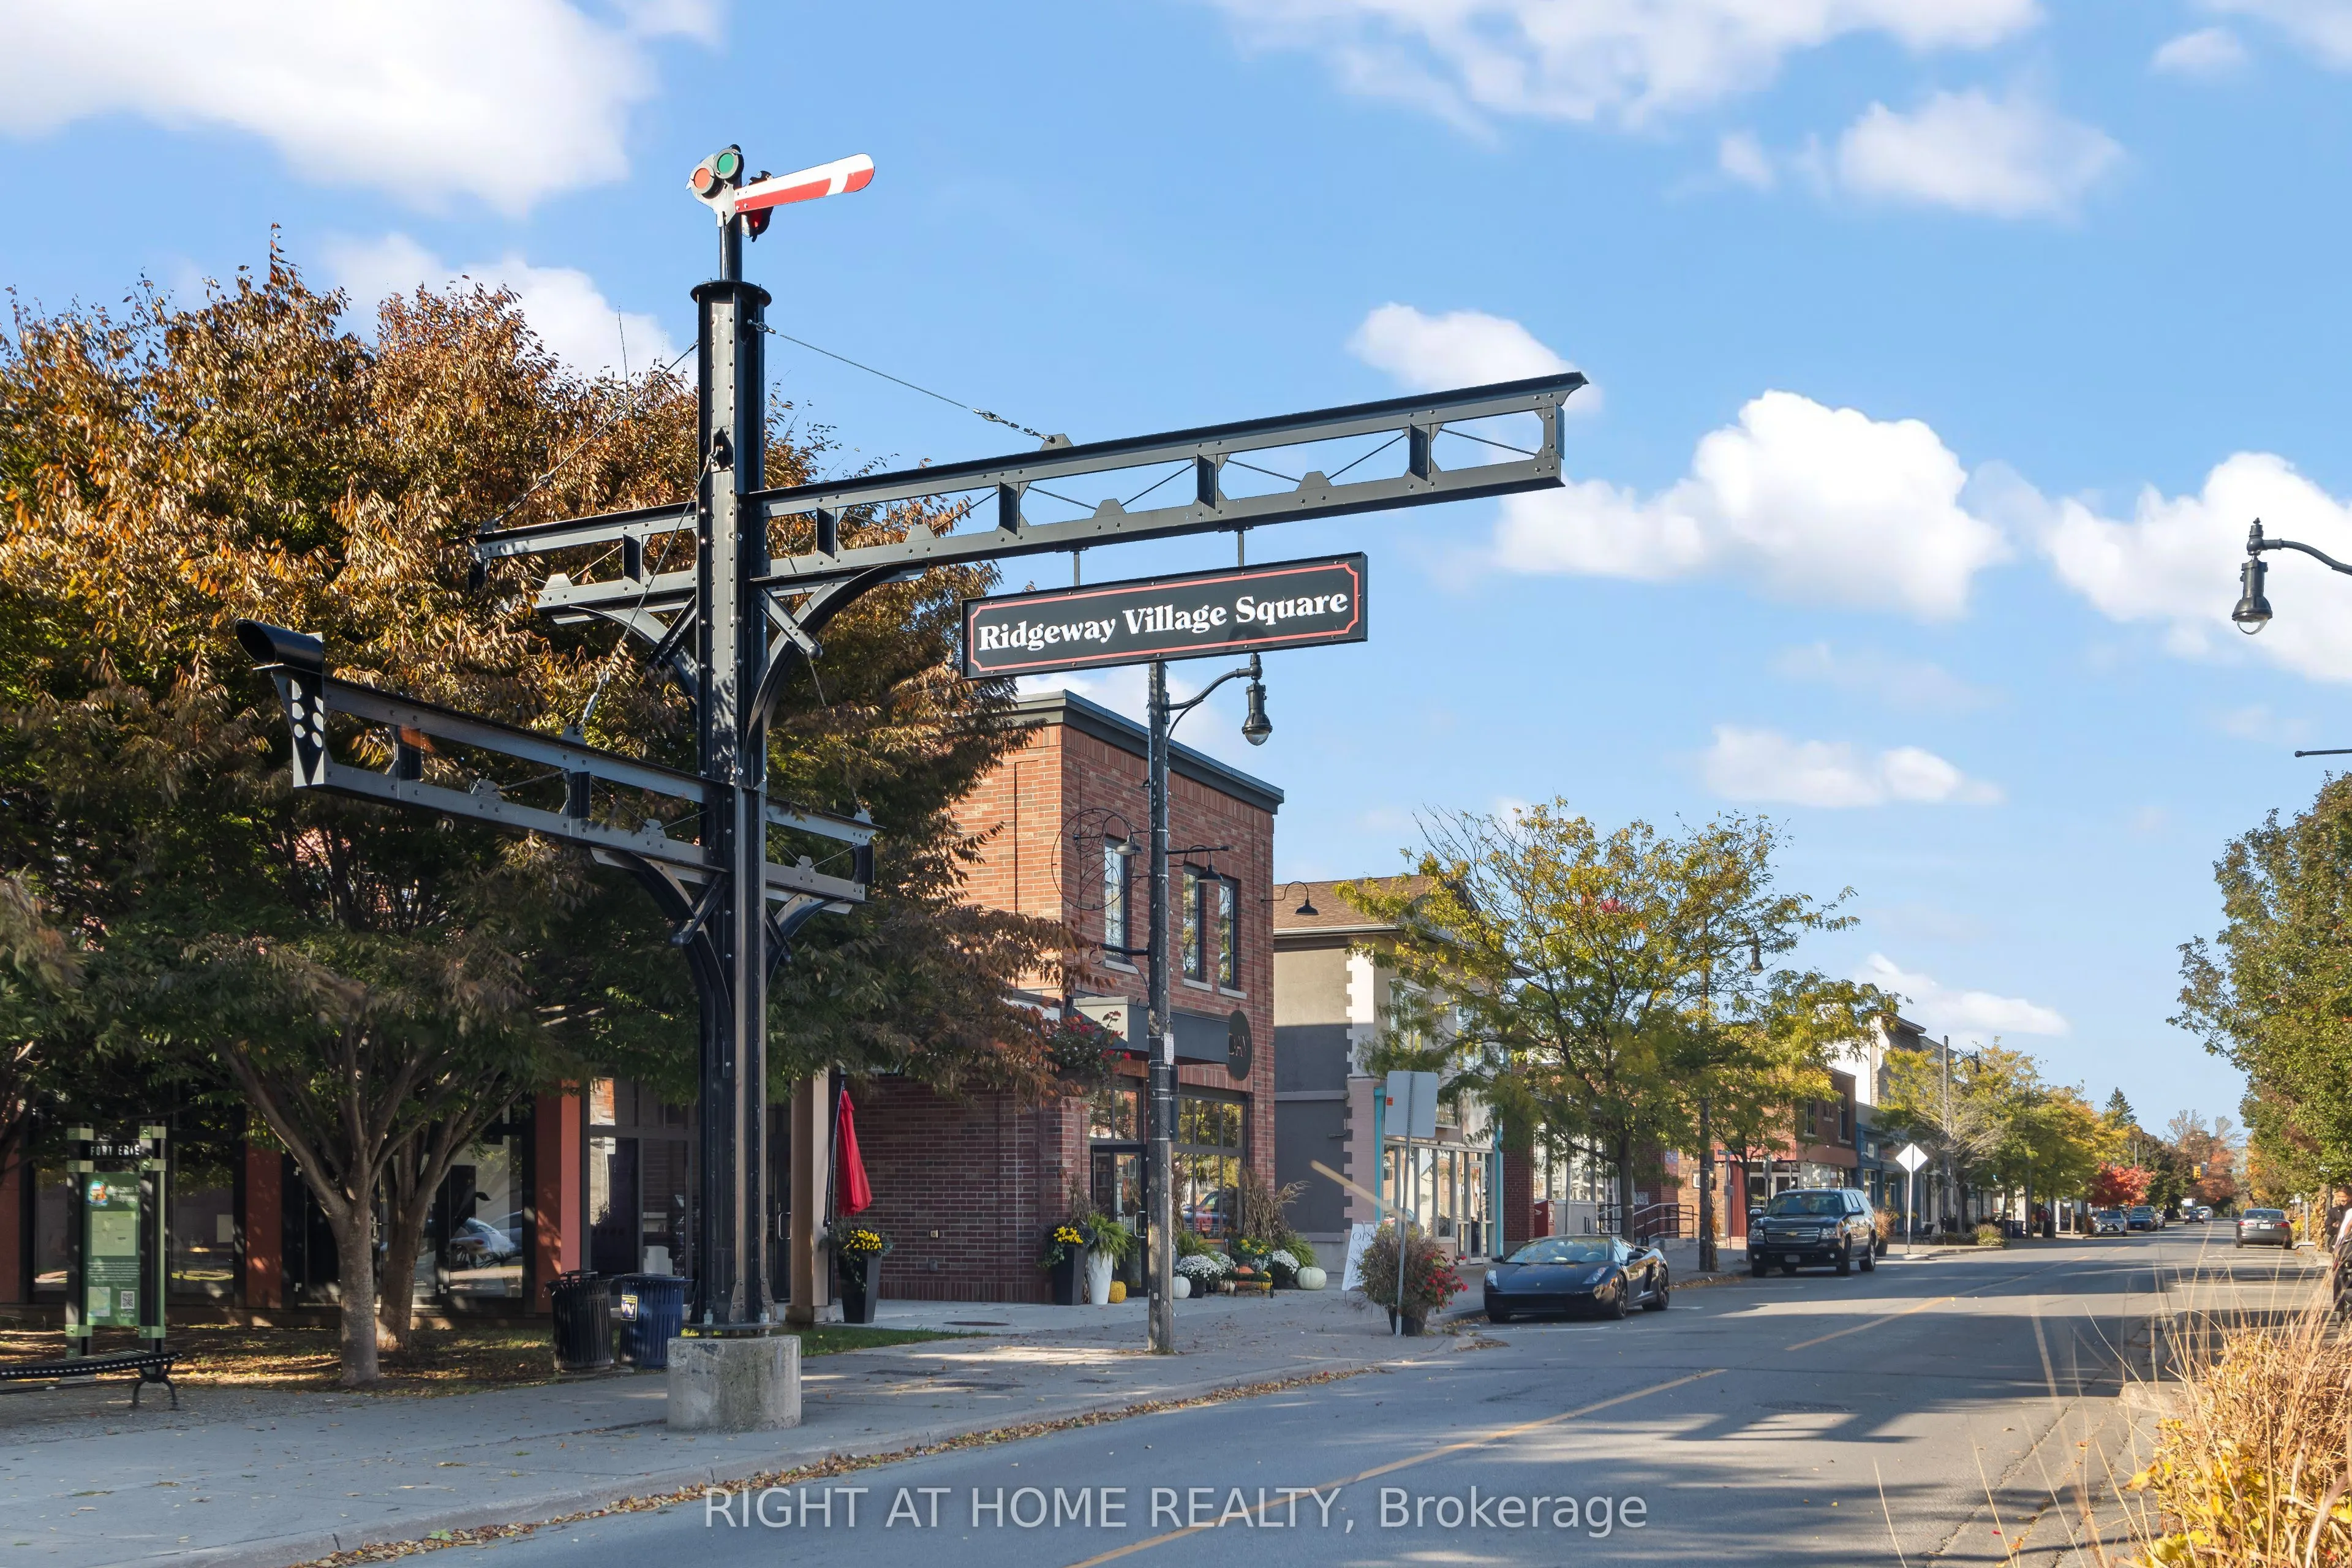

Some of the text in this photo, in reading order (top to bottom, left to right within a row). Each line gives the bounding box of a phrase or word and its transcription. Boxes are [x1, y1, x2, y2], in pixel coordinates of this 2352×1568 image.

[978, 593, 1348, 652] Ridgeway Village Square
[91, 1144, 140, 1156] FORT ERIE
